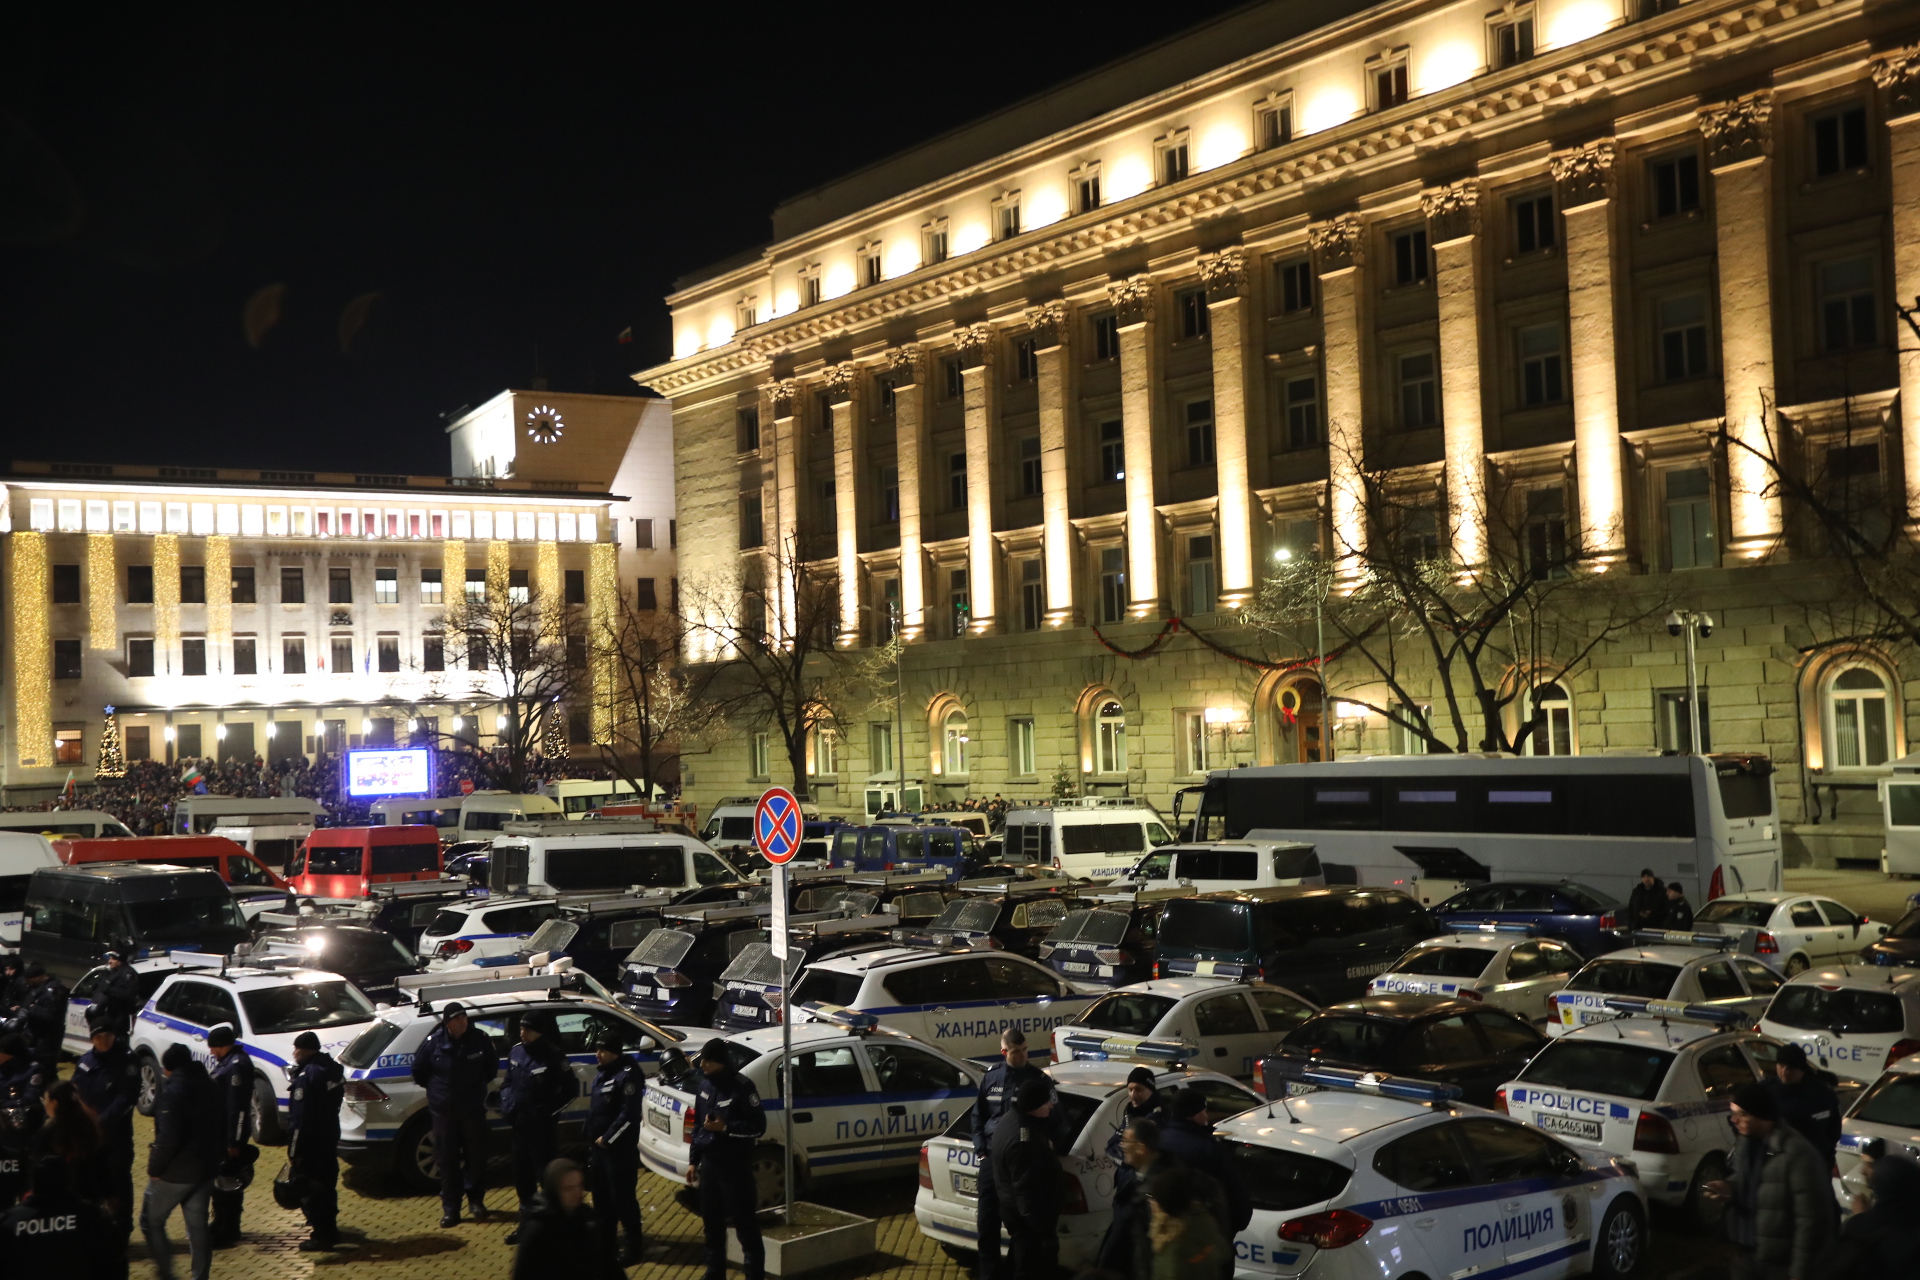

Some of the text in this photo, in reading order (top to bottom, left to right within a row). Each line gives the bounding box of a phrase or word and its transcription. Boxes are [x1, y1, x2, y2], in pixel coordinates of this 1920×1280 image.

[1055, 942, 1098, 951] GENDARMERIE
[1387, 980, 1438, 995] POLICE
[935, 1016, 1063, 1039] ЖАНДАРМЕРИЯ
[1103, 1042, 1134, 1053] POLICE
[1529, 1090, 1606, 1116] POLICE
[836, 1110, 950, 1141] ПОЛИЦИЯ
[15, 1214, 77, 1237] POLICE
[1463, 1206, 1554, 1254] ПОЛИЦИЯ
